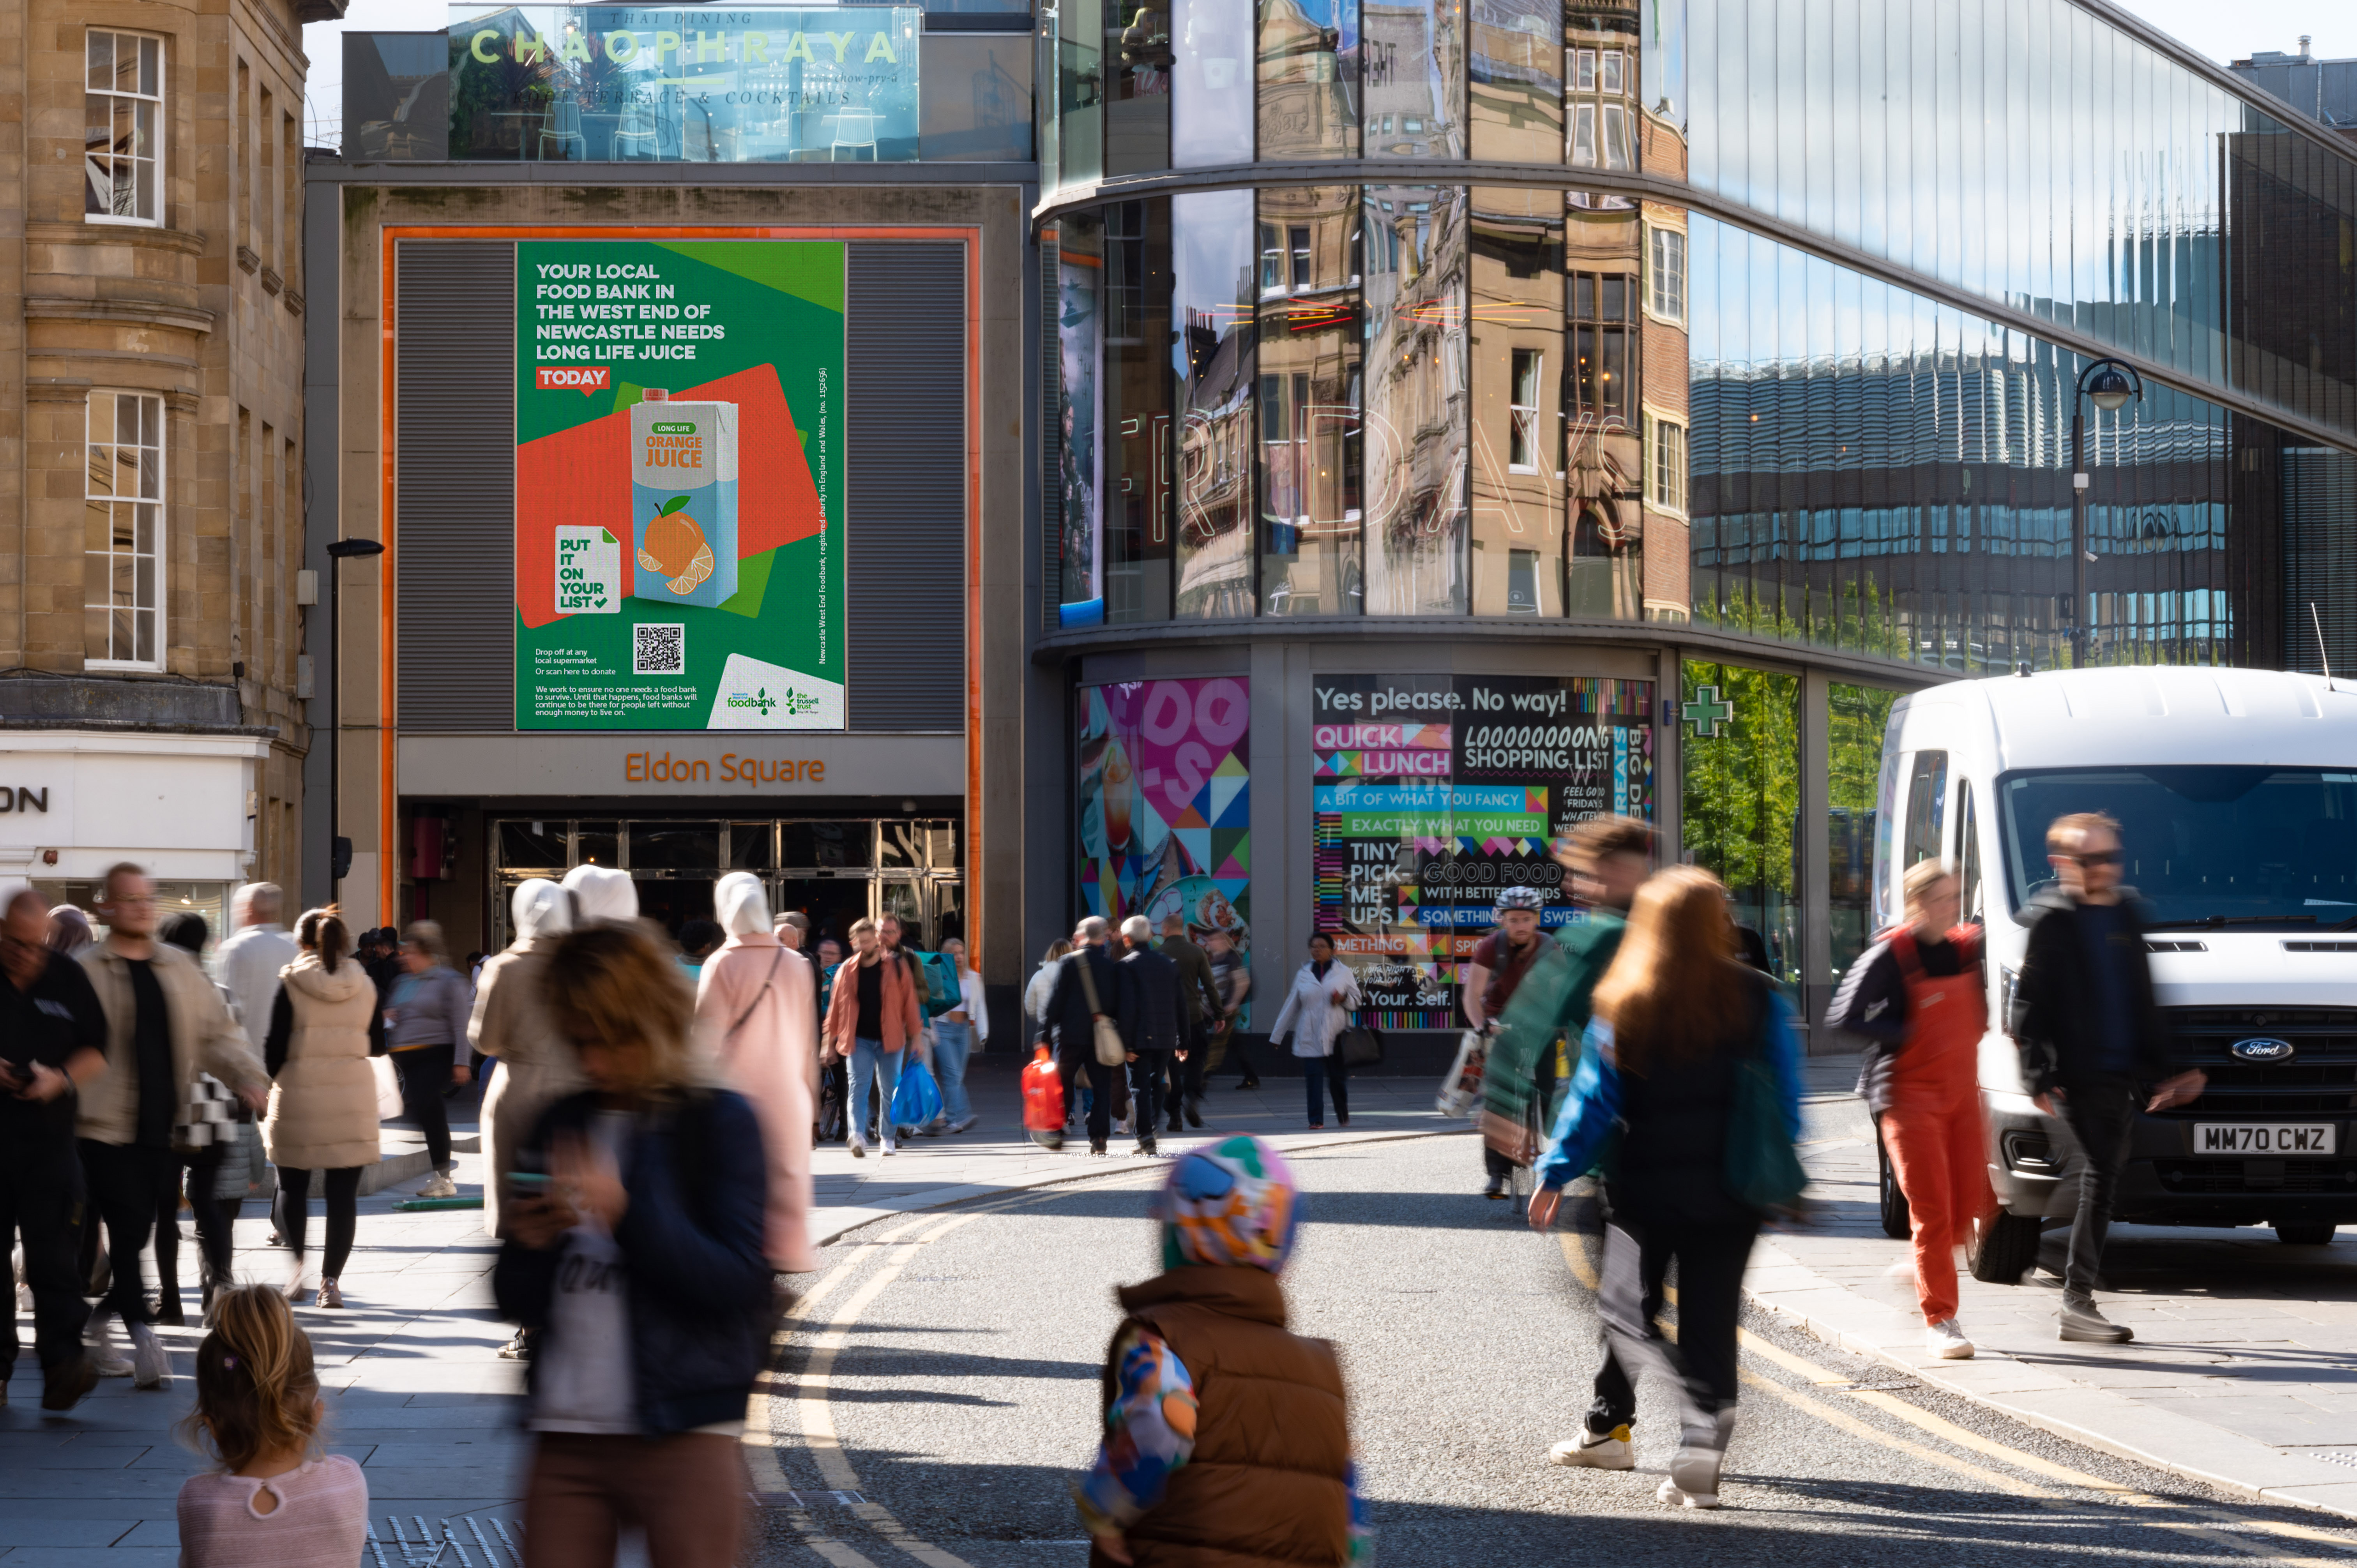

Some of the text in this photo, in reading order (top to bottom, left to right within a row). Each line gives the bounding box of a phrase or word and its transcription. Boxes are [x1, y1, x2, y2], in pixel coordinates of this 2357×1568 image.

[611, 13, 751, 24] THAI DINING
[471, 29, 897, 64] CHAOPHRAYA
[513, 91, 850, 104] ROOF TERRACE & COCKTAILS
[537, 265, 659, 278] YOUR LOCAL
[537, 285, 674, 298] FOOD BANK IN
[536, 305, 710, 319] THE WEST END OF
[537, 325, 724, 339] NEWCASTLE NEEDS
[537, 345, 695, 359] LONG LIFE JUICE
[540, 371, 606, 384] TODAY
[646, 436, 702, 448] ORANGE
[646, 449, 702, 468] JUICE
[561, 540, 590, 551] PUT
[561, 554, 574, 565] IT
[560, 568, 583, 580] ON
[560, 583, 604, 594] YOUR
[561, 596, 592, 608] LIST
[728, 697, 776, 707] foodbank
[1315, 688, 1565, 717] Yes please. No way!
[1316, 726, 1400, 748] QUICK
[1629, 729, 1641, 775] BIG
[1365, 752, 1449, 773] LUNCH
[1465, 749, 1609, 770] SHOPPING LIST
[627, 752, 824, 786] Eldon Square
[1564, 786, 1605, 797] FEEL GOOD
[1320, 793, 1519, 806] A BIT OF WHAT YOU FANCY
[1567, 799, 1603, 808] FRIDAYS
[1352, 819, 1540, 832] EXACTLY WHAT YOU NEED
[1350, 843, 1401, 860] TINY
[1351, 864, 1410, 882] PICK-
[1424, 862, 1561, 884] GOOD FOOD
[1351, 886, 1390, 903] ME-
[1424, 886, 1462, 899] WITH
[1351, 907, 1392, 925] UPS
[1544, 911, 1587, 923] SWEET
[1368, 991, 1413, 1006] Your.
[1415, 991, 1451, 1006] Self.
[2246, 1042, 2279, 1055] Ford
[2206, 1128, 2324, 1150] MM70 CWZ
